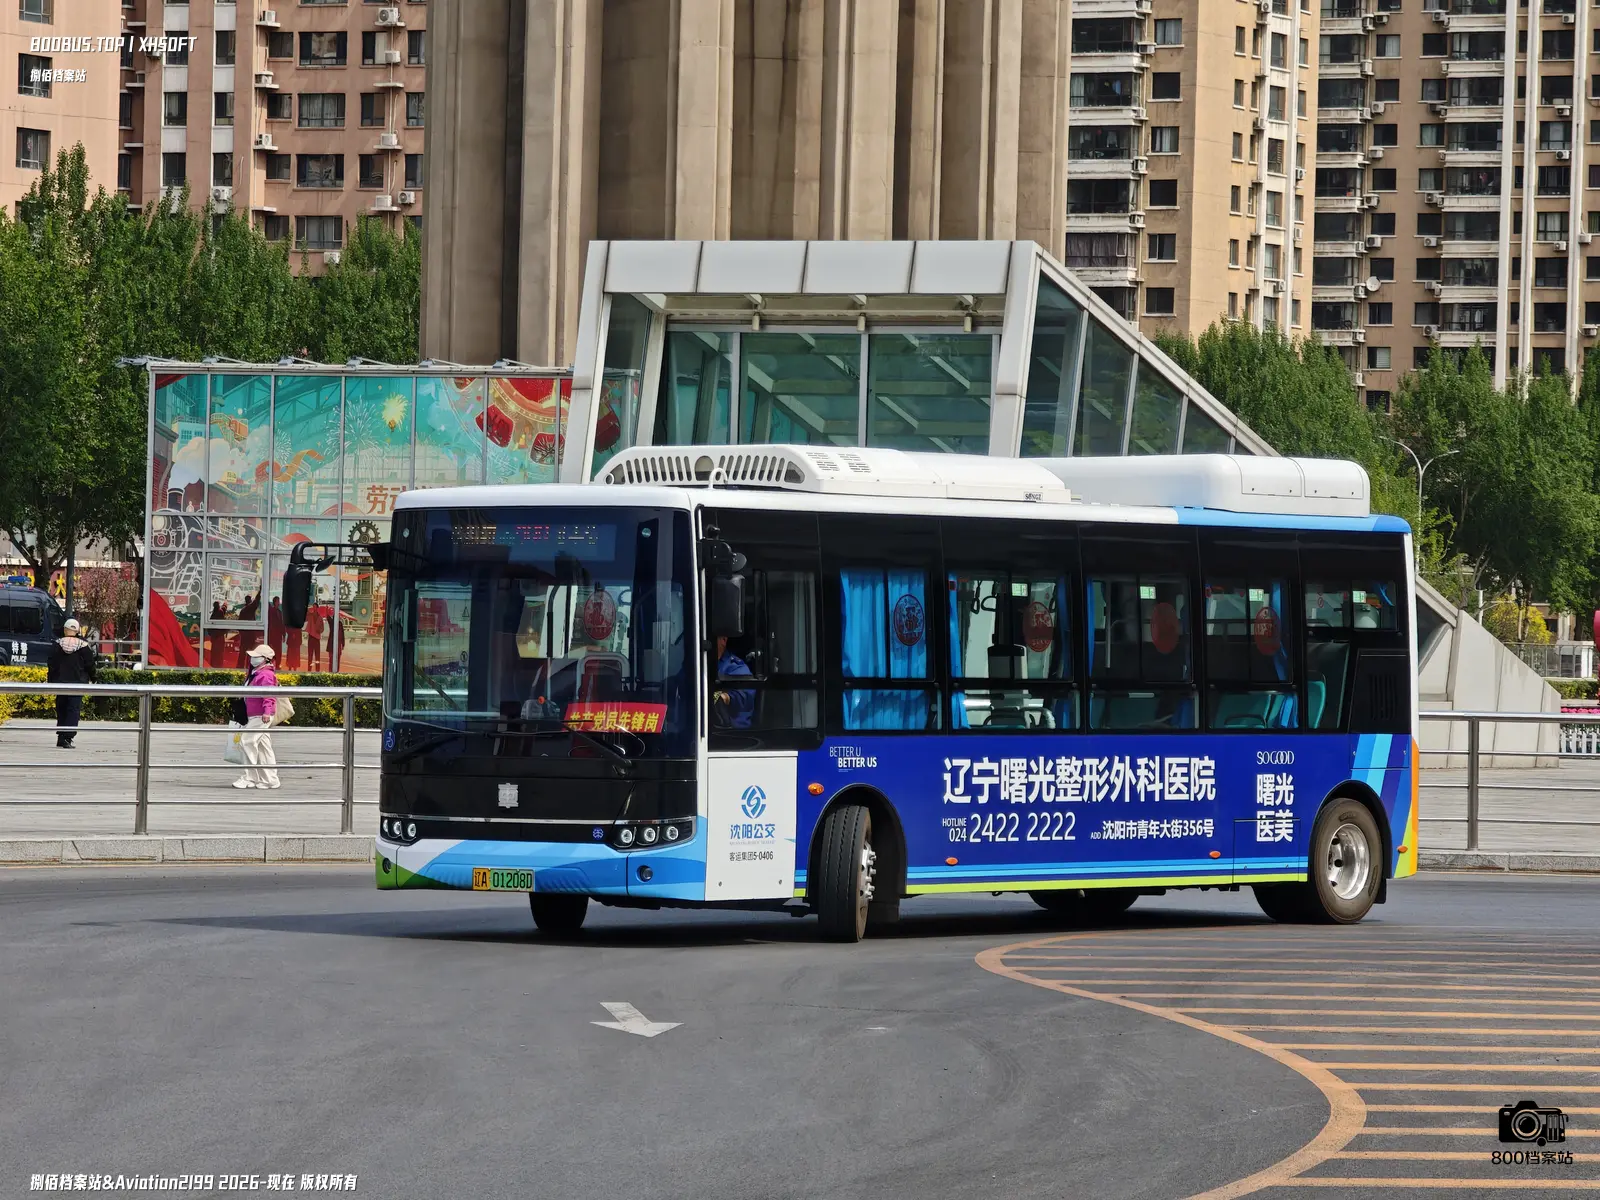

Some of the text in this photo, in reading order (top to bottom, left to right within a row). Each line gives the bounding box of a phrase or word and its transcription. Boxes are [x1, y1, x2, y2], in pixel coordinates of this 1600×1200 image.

[567, 710, 660, 733] 共产党员先锋岗
[829, 746, 862, 758] BETTER U
[838, 757, 878, 768] BETTER US
[943, 755, 1216, 804] 辽宁曙光整形外科医院
[1256, 772, 1295, 807] 曙光
[730, 823, 776, 840] 沈阳公交
[942, 817, 967, 827] HOTLINE
[949, 811, 1076, 843] 024 2422 2222
[1102, 818, 1215, 840] 沈阳市青年大街356号
[1256, 808, 1294, 843] 医美
